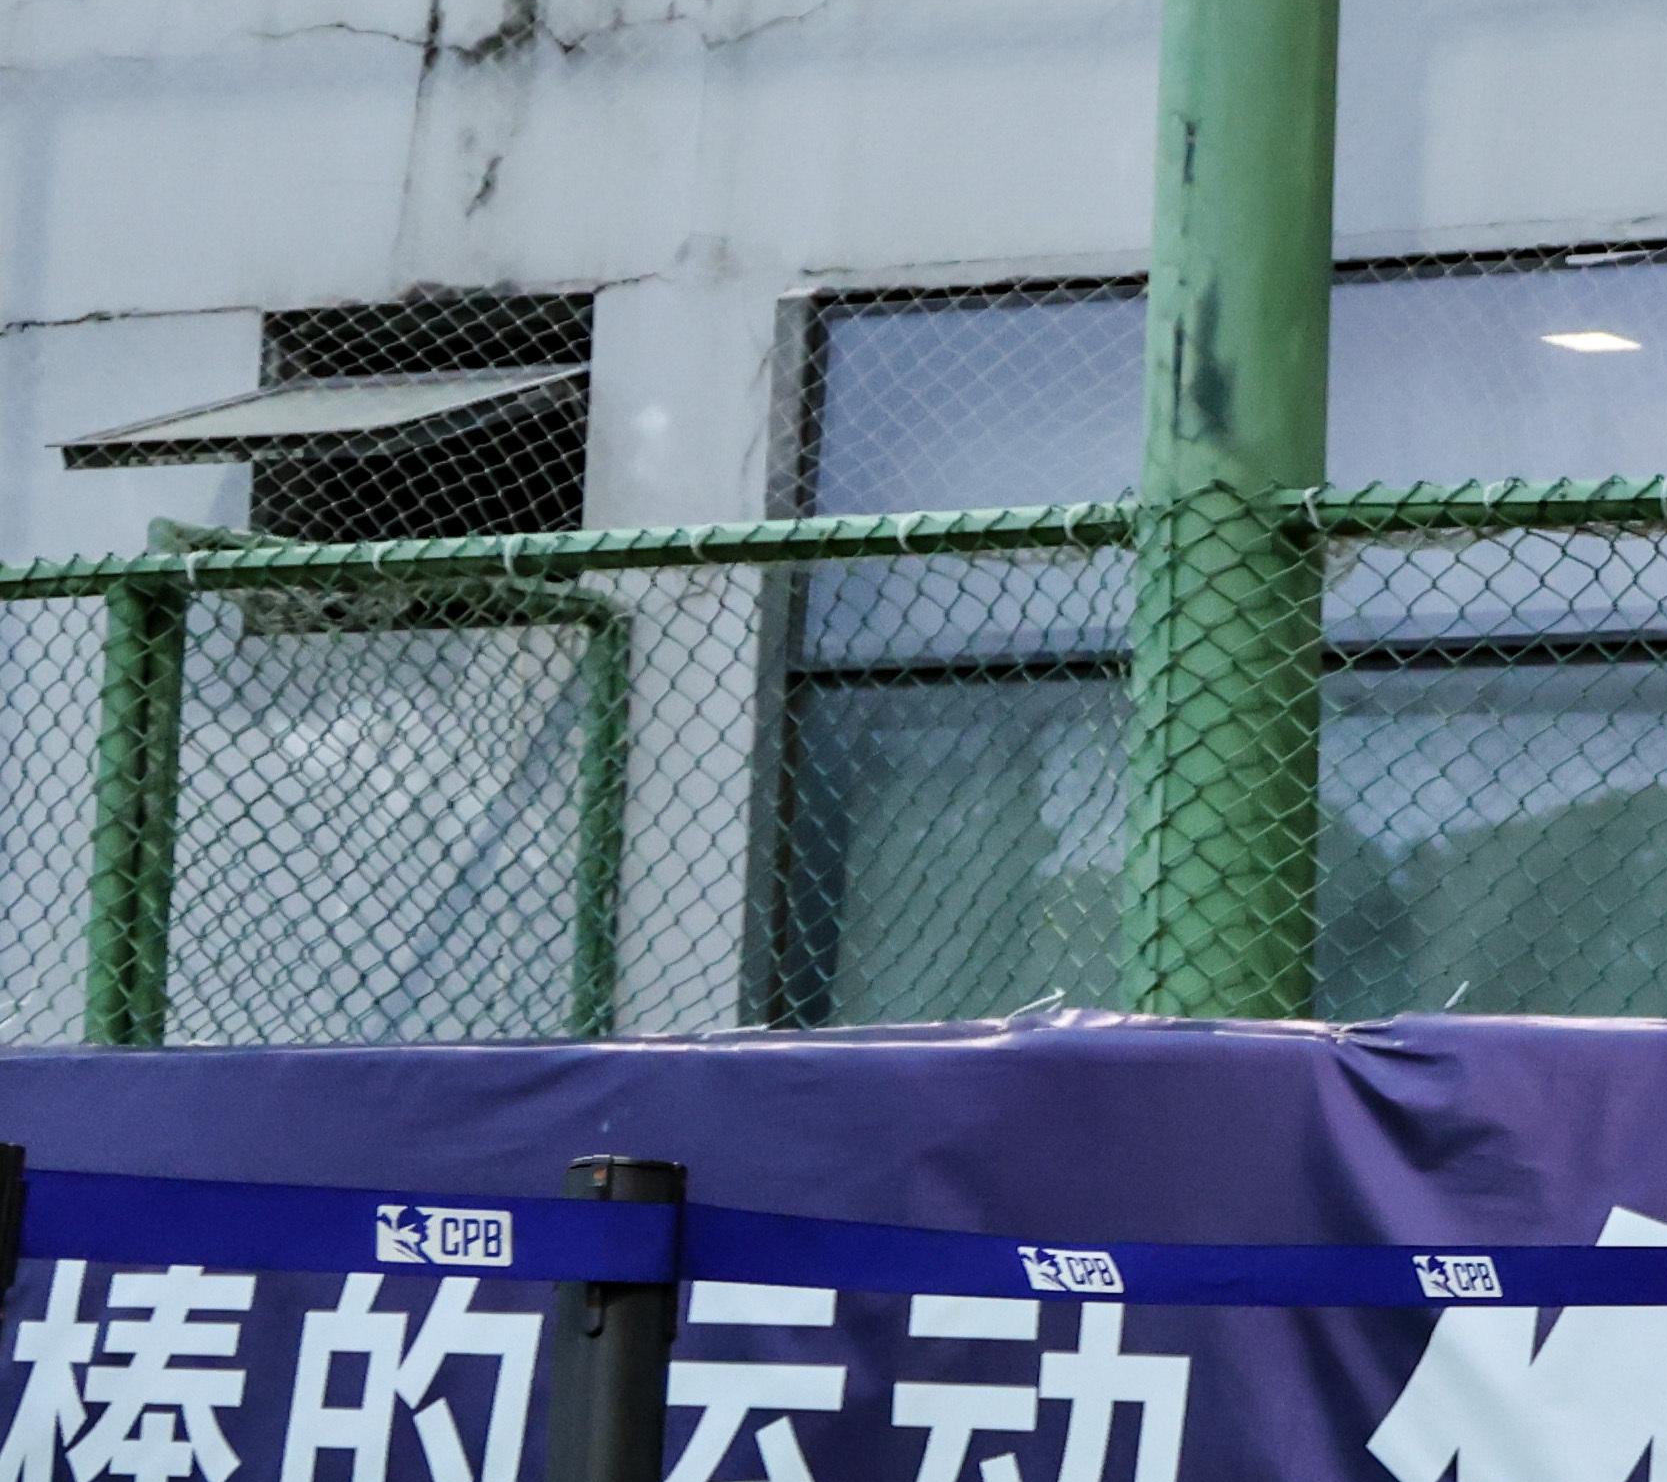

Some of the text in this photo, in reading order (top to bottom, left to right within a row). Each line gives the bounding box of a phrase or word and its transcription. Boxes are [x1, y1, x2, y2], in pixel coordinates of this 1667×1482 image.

[441, 1217, 502, 1258] CPB
[1065, 1256, 1115, 1286] CPB
[1453, 1262, 1495, 1292] CPB
